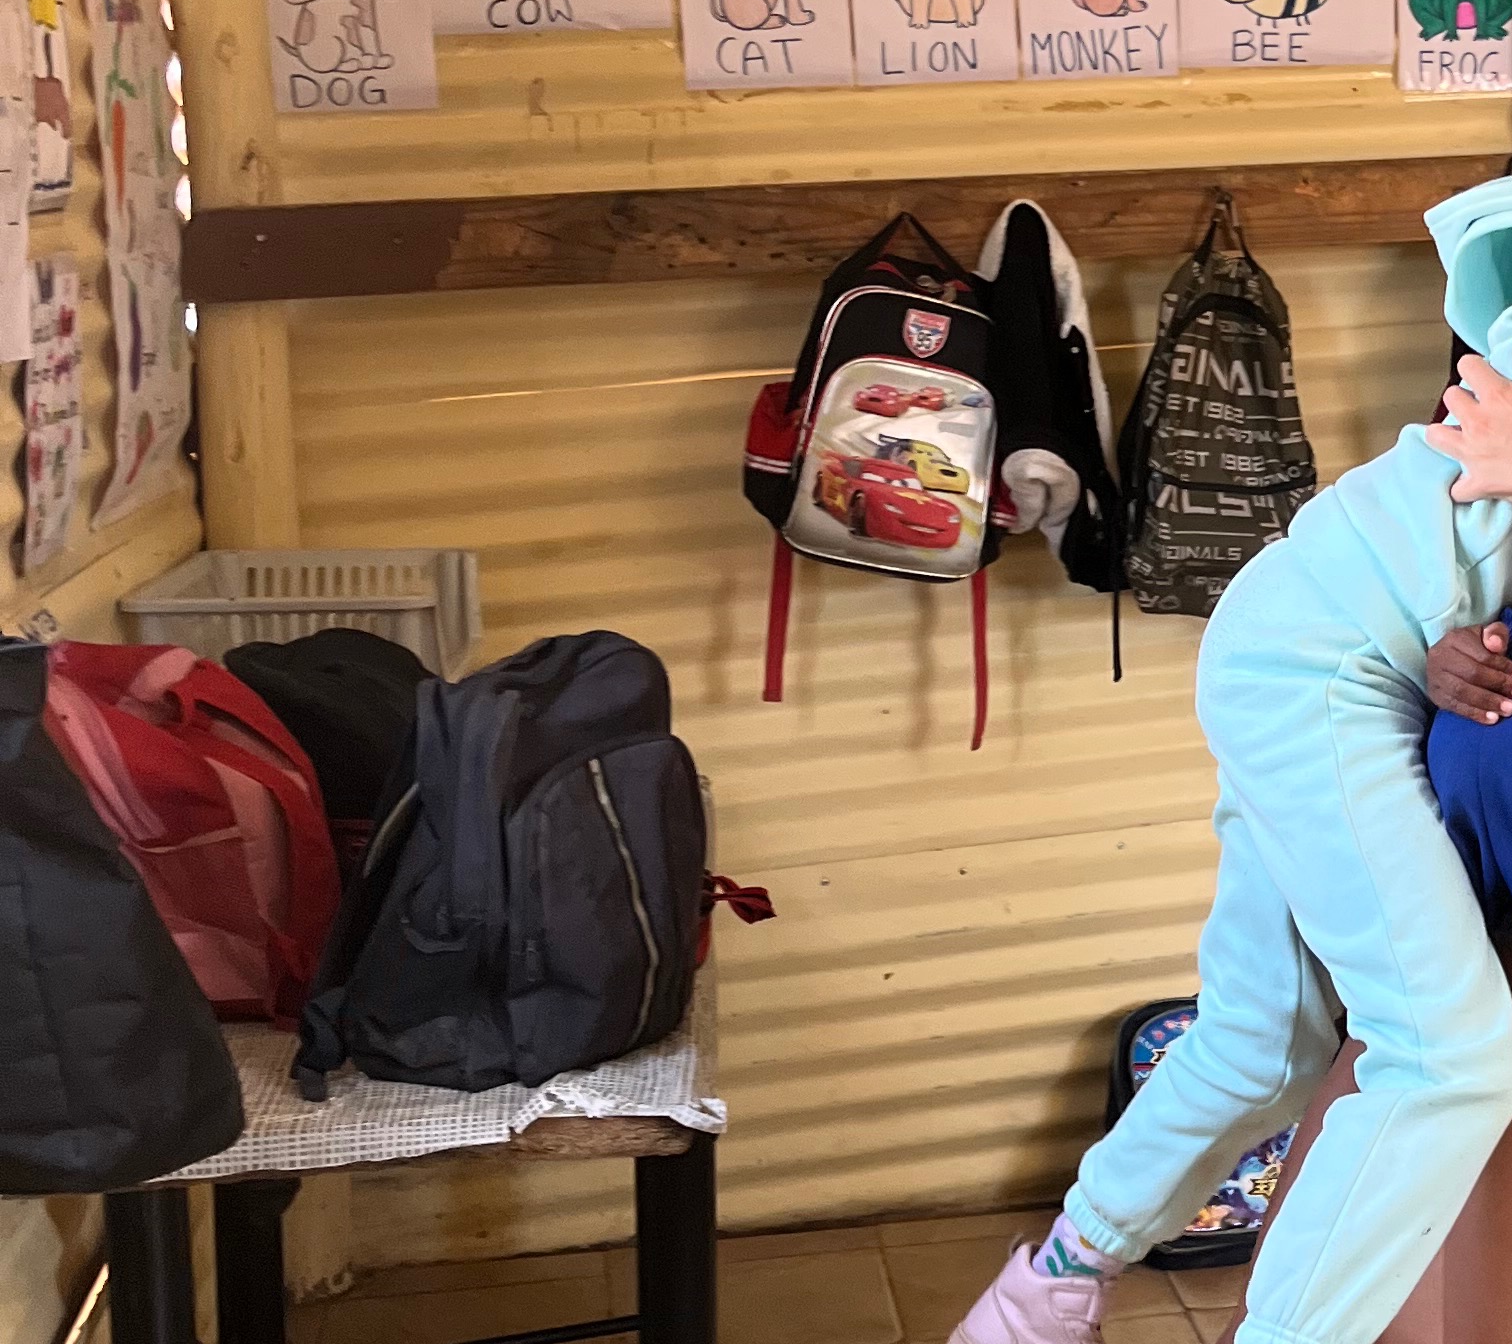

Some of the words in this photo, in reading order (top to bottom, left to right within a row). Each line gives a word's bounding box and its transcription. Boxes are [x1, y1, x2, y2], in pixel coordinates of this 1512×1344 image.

[715, 36, 802, 75] CAT
[879, 39, 978, 75] LION
[1029, 24, 1169, 75] MONKEY
[1231, 29, 1312, 64] BEE
[1418, 49, 1501, 86] FROG
[289, 74, 387, 109] DOG
